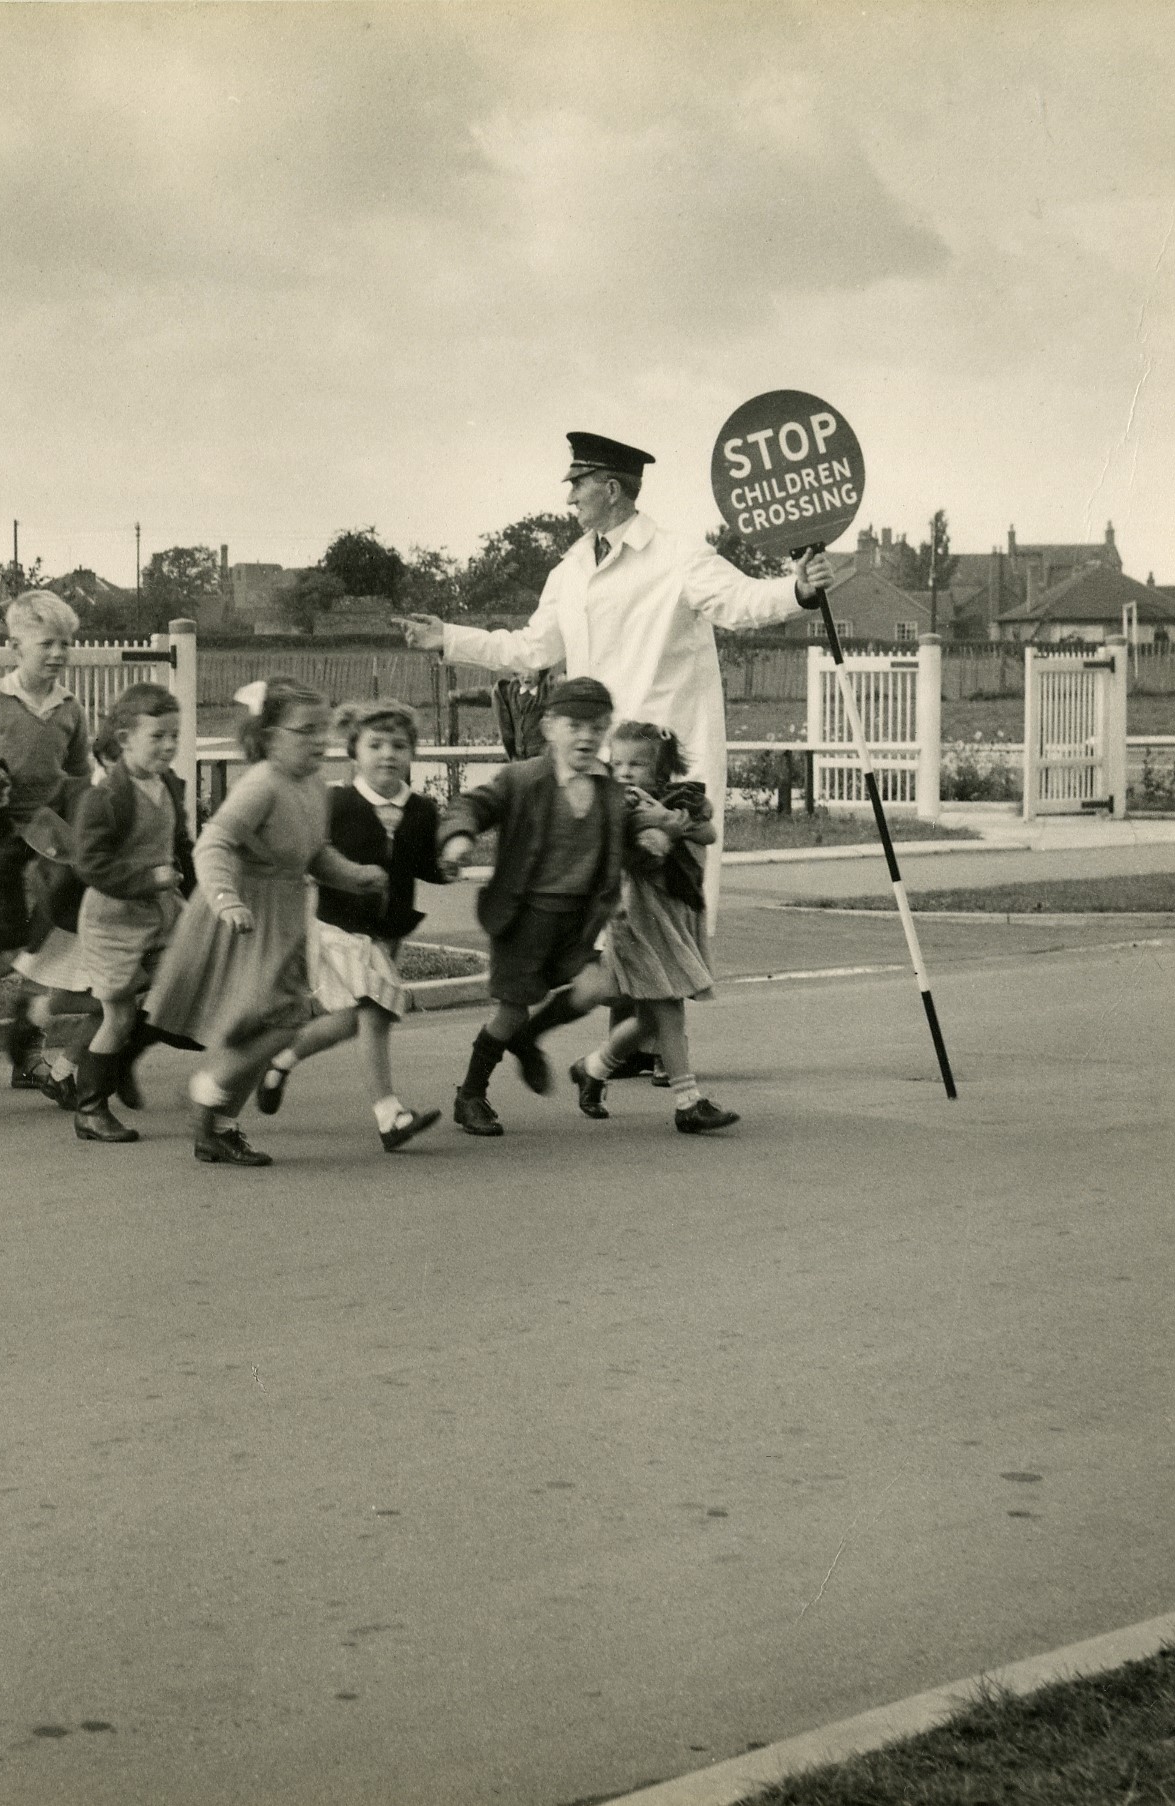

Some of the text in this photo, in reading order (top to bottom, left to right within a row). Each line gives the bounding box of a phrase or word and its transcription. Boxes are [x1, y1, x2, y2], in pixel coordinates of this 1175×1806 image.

[723, 411, 837, 479] STOP
[731, 457, 852, 509] CHILDREN
[738, 483, 858, 534] CROSSING
